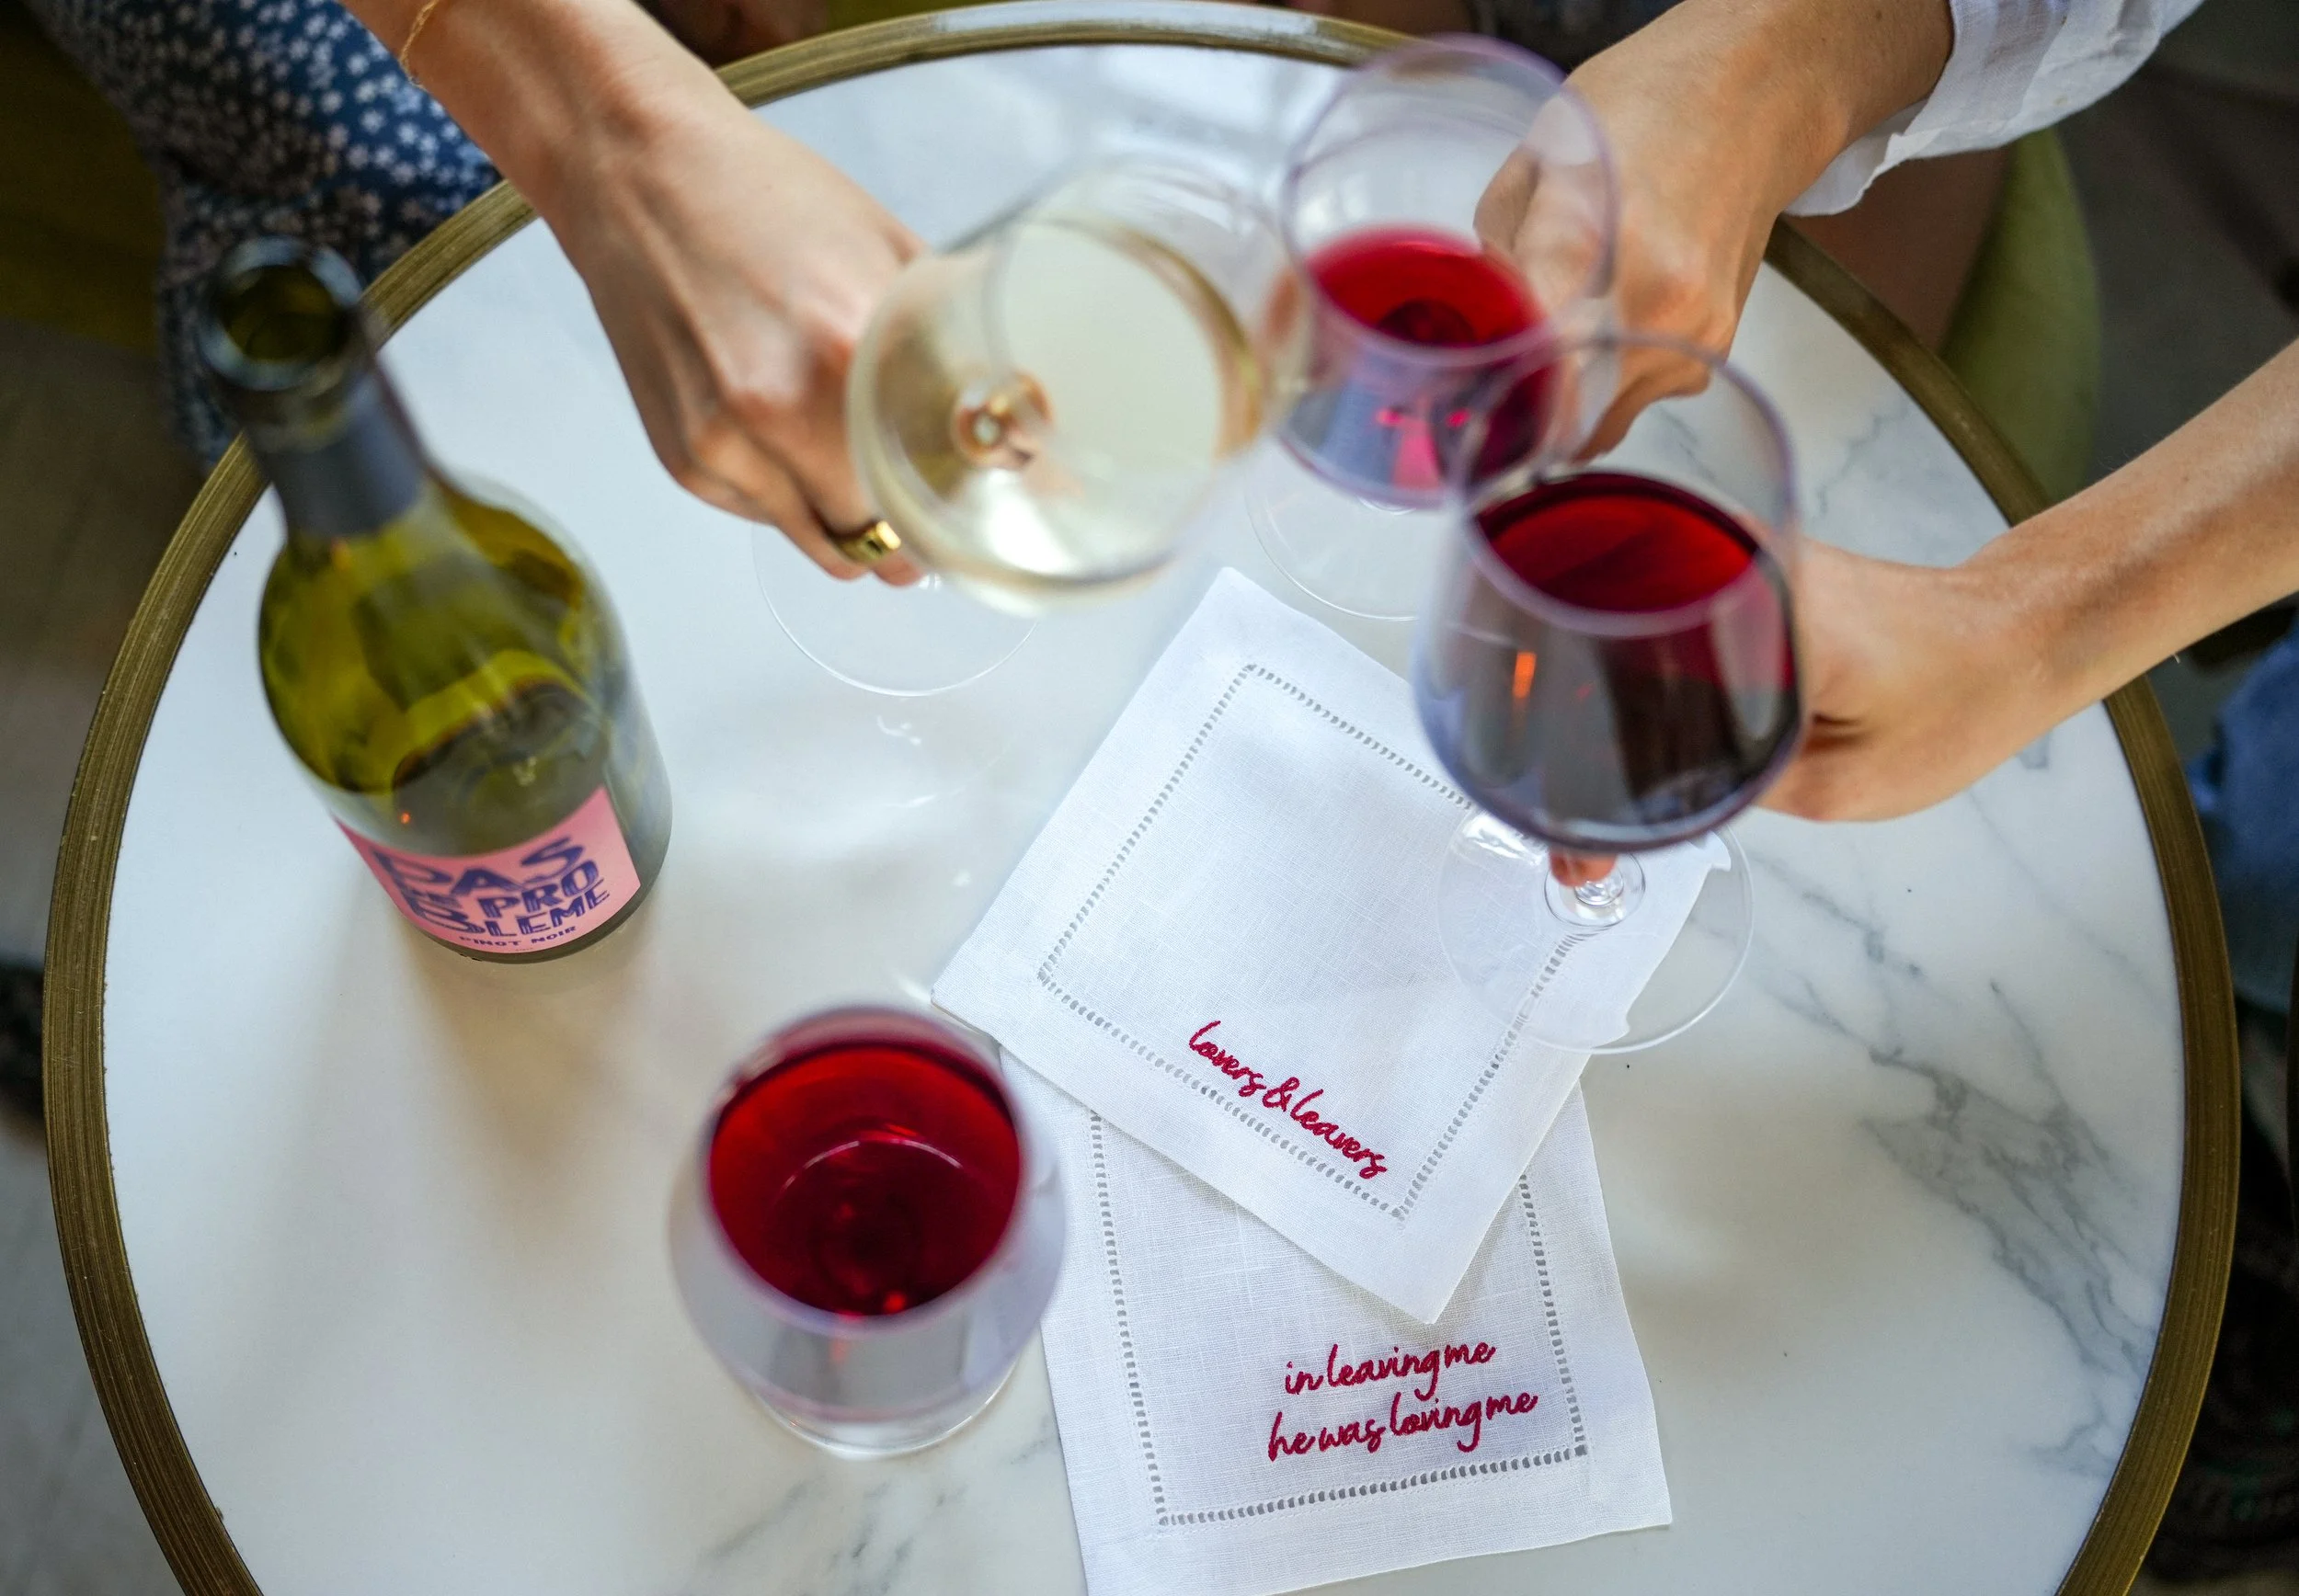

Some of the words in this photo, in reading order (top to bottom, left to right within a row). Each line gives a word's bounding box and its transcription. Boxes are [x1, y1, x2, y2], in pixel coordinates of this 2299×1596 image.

[372, 836, 586, 895] PAS
[476, 859, 600, 918] PRO
[459, 934, 520, 948] PINOT
[531, 925, 578, 944] NOIR
[1188, 1020, 1266, 1098] lovers
[1262, 1077, 1300, 1112] &
[1290, 1089, 1388, 1180] leavers
[1285, 1361, 1324, 1396] in
[1327, 1343, 1441, 1401] leaving
[1444, 1341, 1496, 1369] me
[1267, 1411, 1316, 1462] he
[1318, 1419, 1386, 1454] was
[1390, 1392, 1482, 1453] loving
[1485, 1392, 1538, 1420] me
